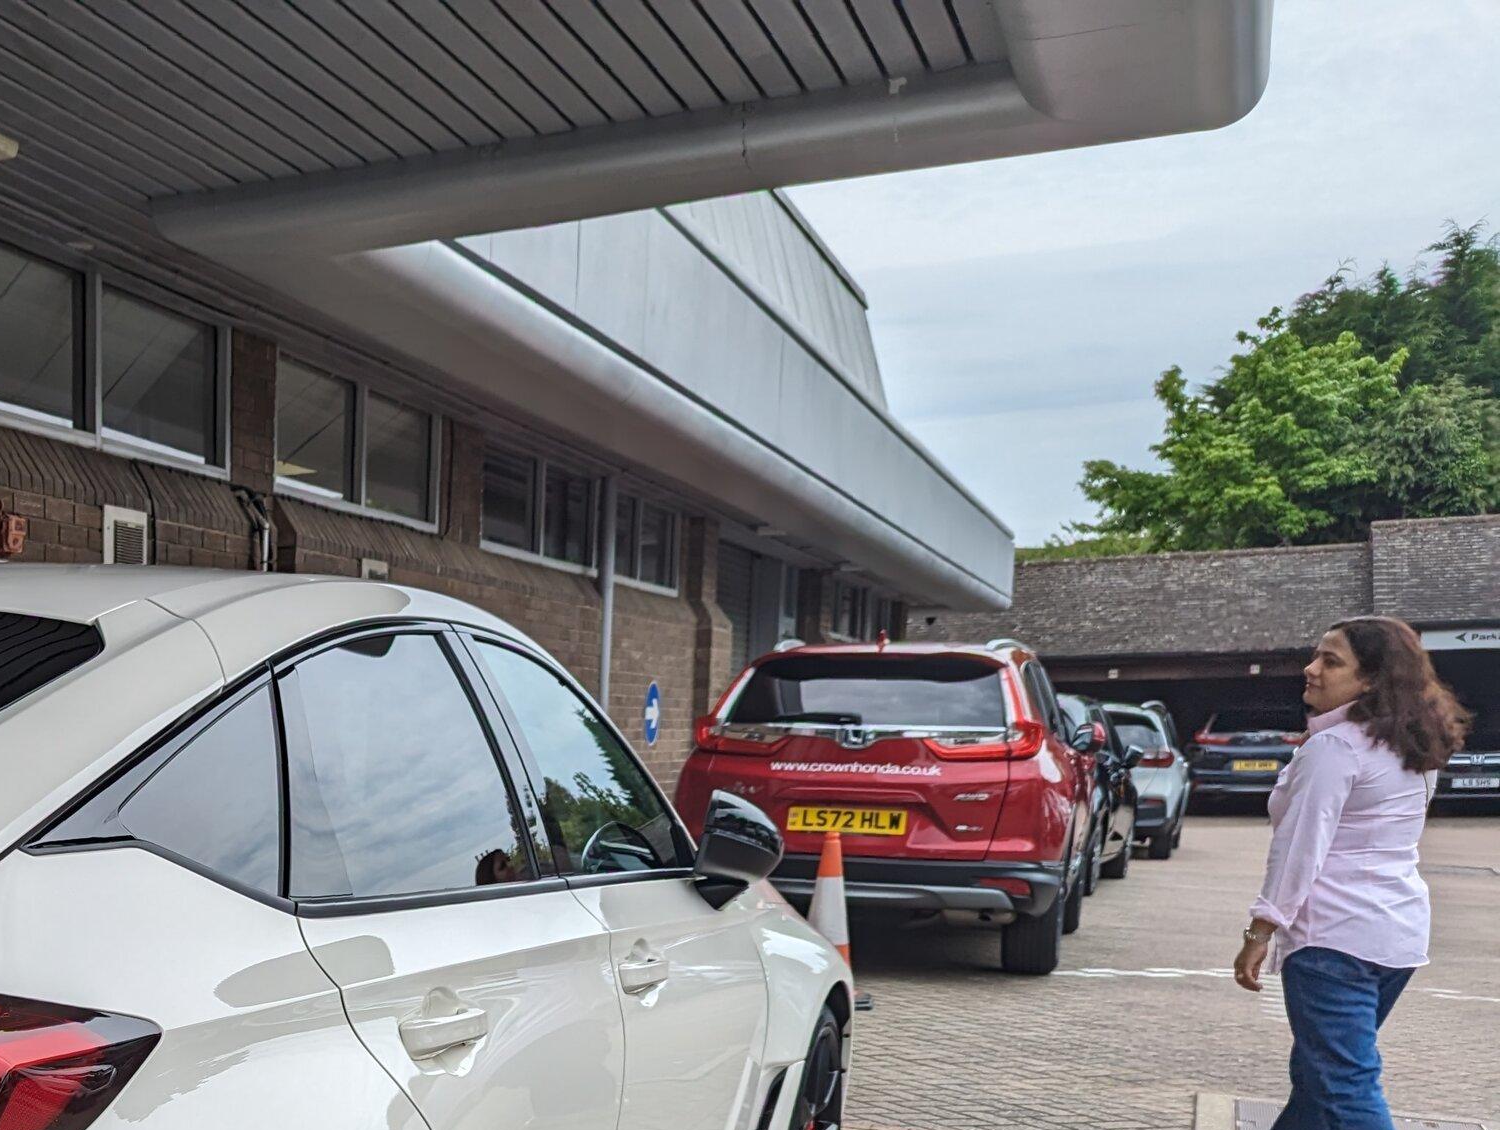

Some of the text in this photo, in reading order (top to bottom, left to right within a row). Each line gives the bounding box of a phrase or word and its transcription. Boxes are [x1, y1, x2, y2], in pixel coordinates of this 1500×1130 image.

[1471, 633, 1500, 641] Park
[770, 761, 942, 777] www.crownhonda.co.uk
[802, 809, 903, 830] LS72 HLW
